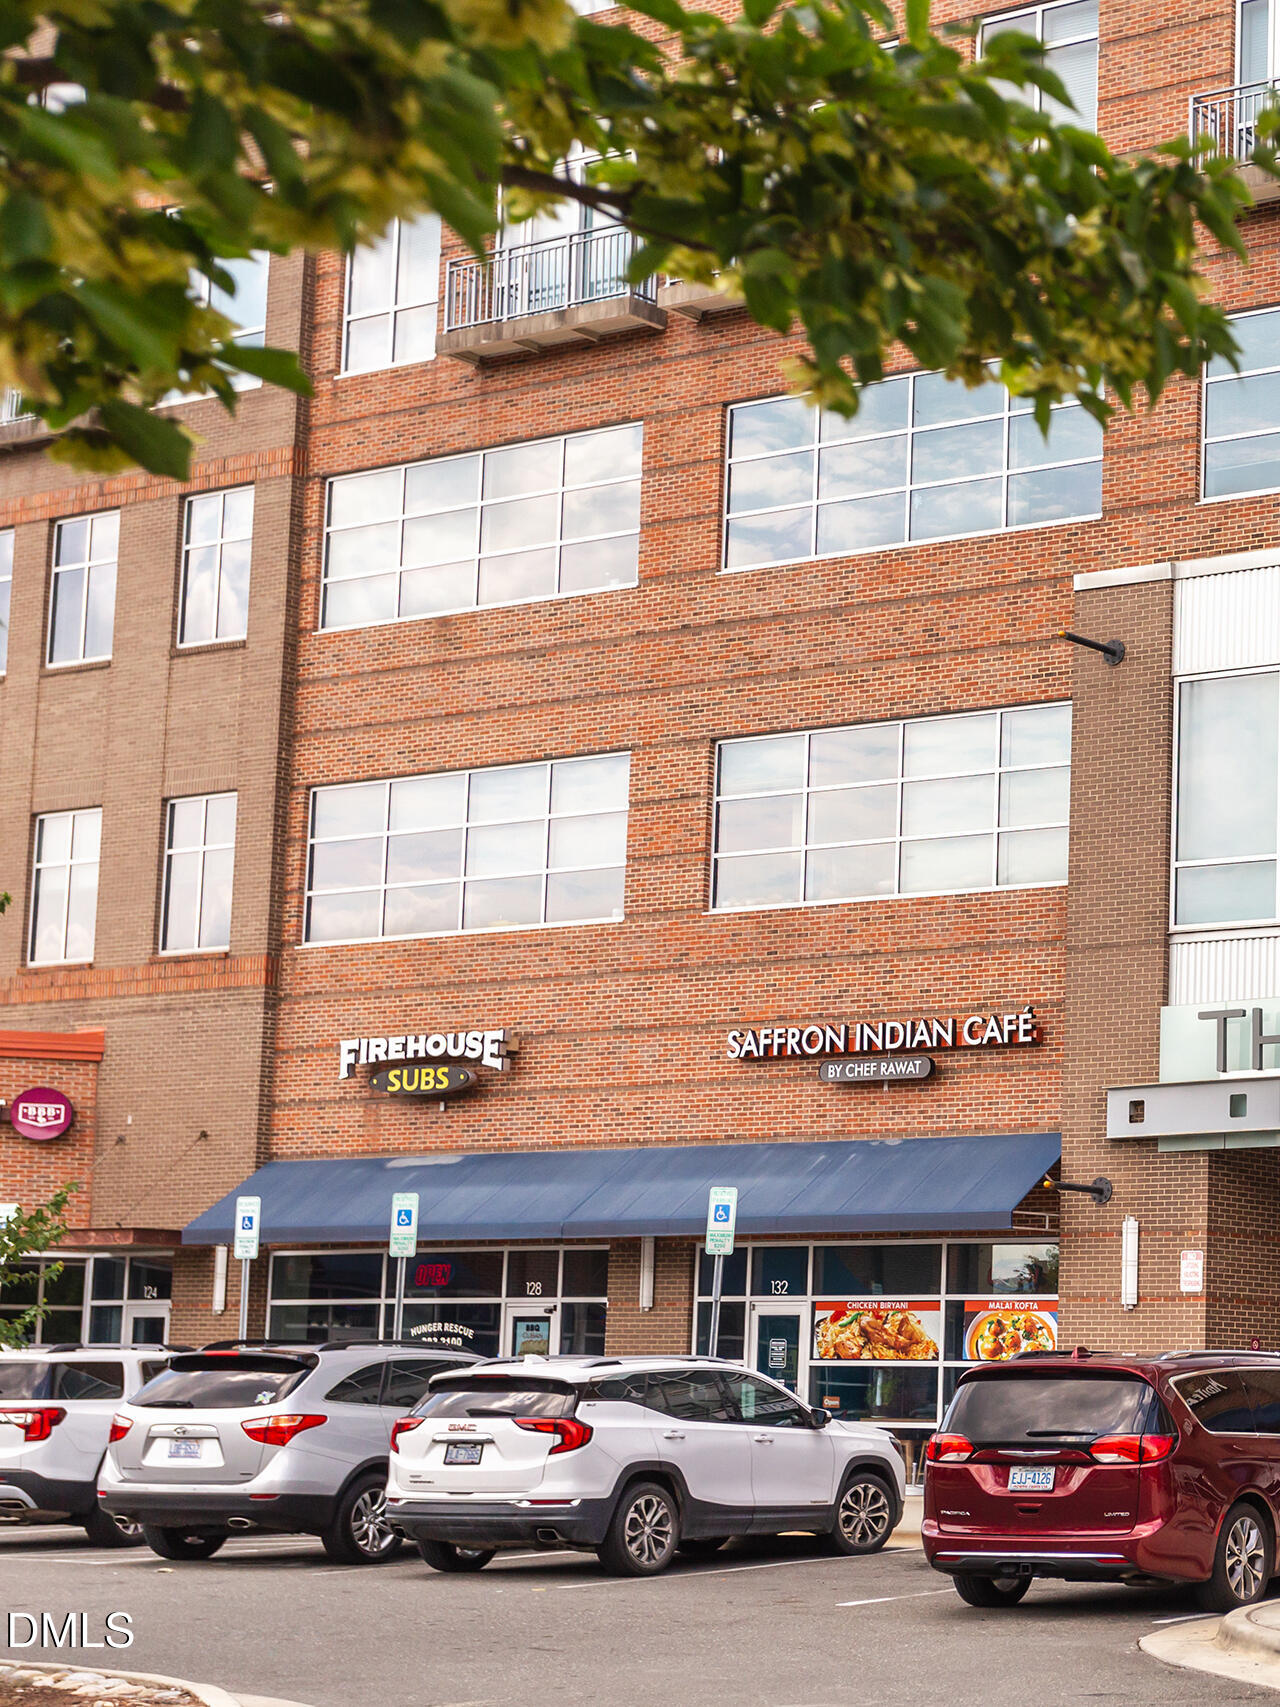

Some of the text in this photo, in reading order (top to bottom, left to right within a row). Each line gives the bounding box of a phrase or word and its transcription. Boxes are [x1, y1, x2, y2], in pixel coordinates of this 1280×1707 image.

[726, 1006, 1034, 1059] SAFFRON INDIAN CAFÉ
[338, 1028, 505, 1080] FIREHOUSE
[827, 1060, 922, 1079] BY CHEF RAWAT
[387, 1067, 449, 1092] SUBS
[415, 1264, 451, 1286] OPEN
[143, 1285, 157, 1299] 124
[526, 1281, 542, 1296] 128
[770, 1280, 788, 1295] 132
[847, 1301, 909, 1310] CHICKEN BIRYANI
[988, 1301, 1039, 1310] MALAI KOFTA
[444, 1322, 475, 1340] RESCUE
[1011, 1472, 1051, 1485] EJJ-4126
